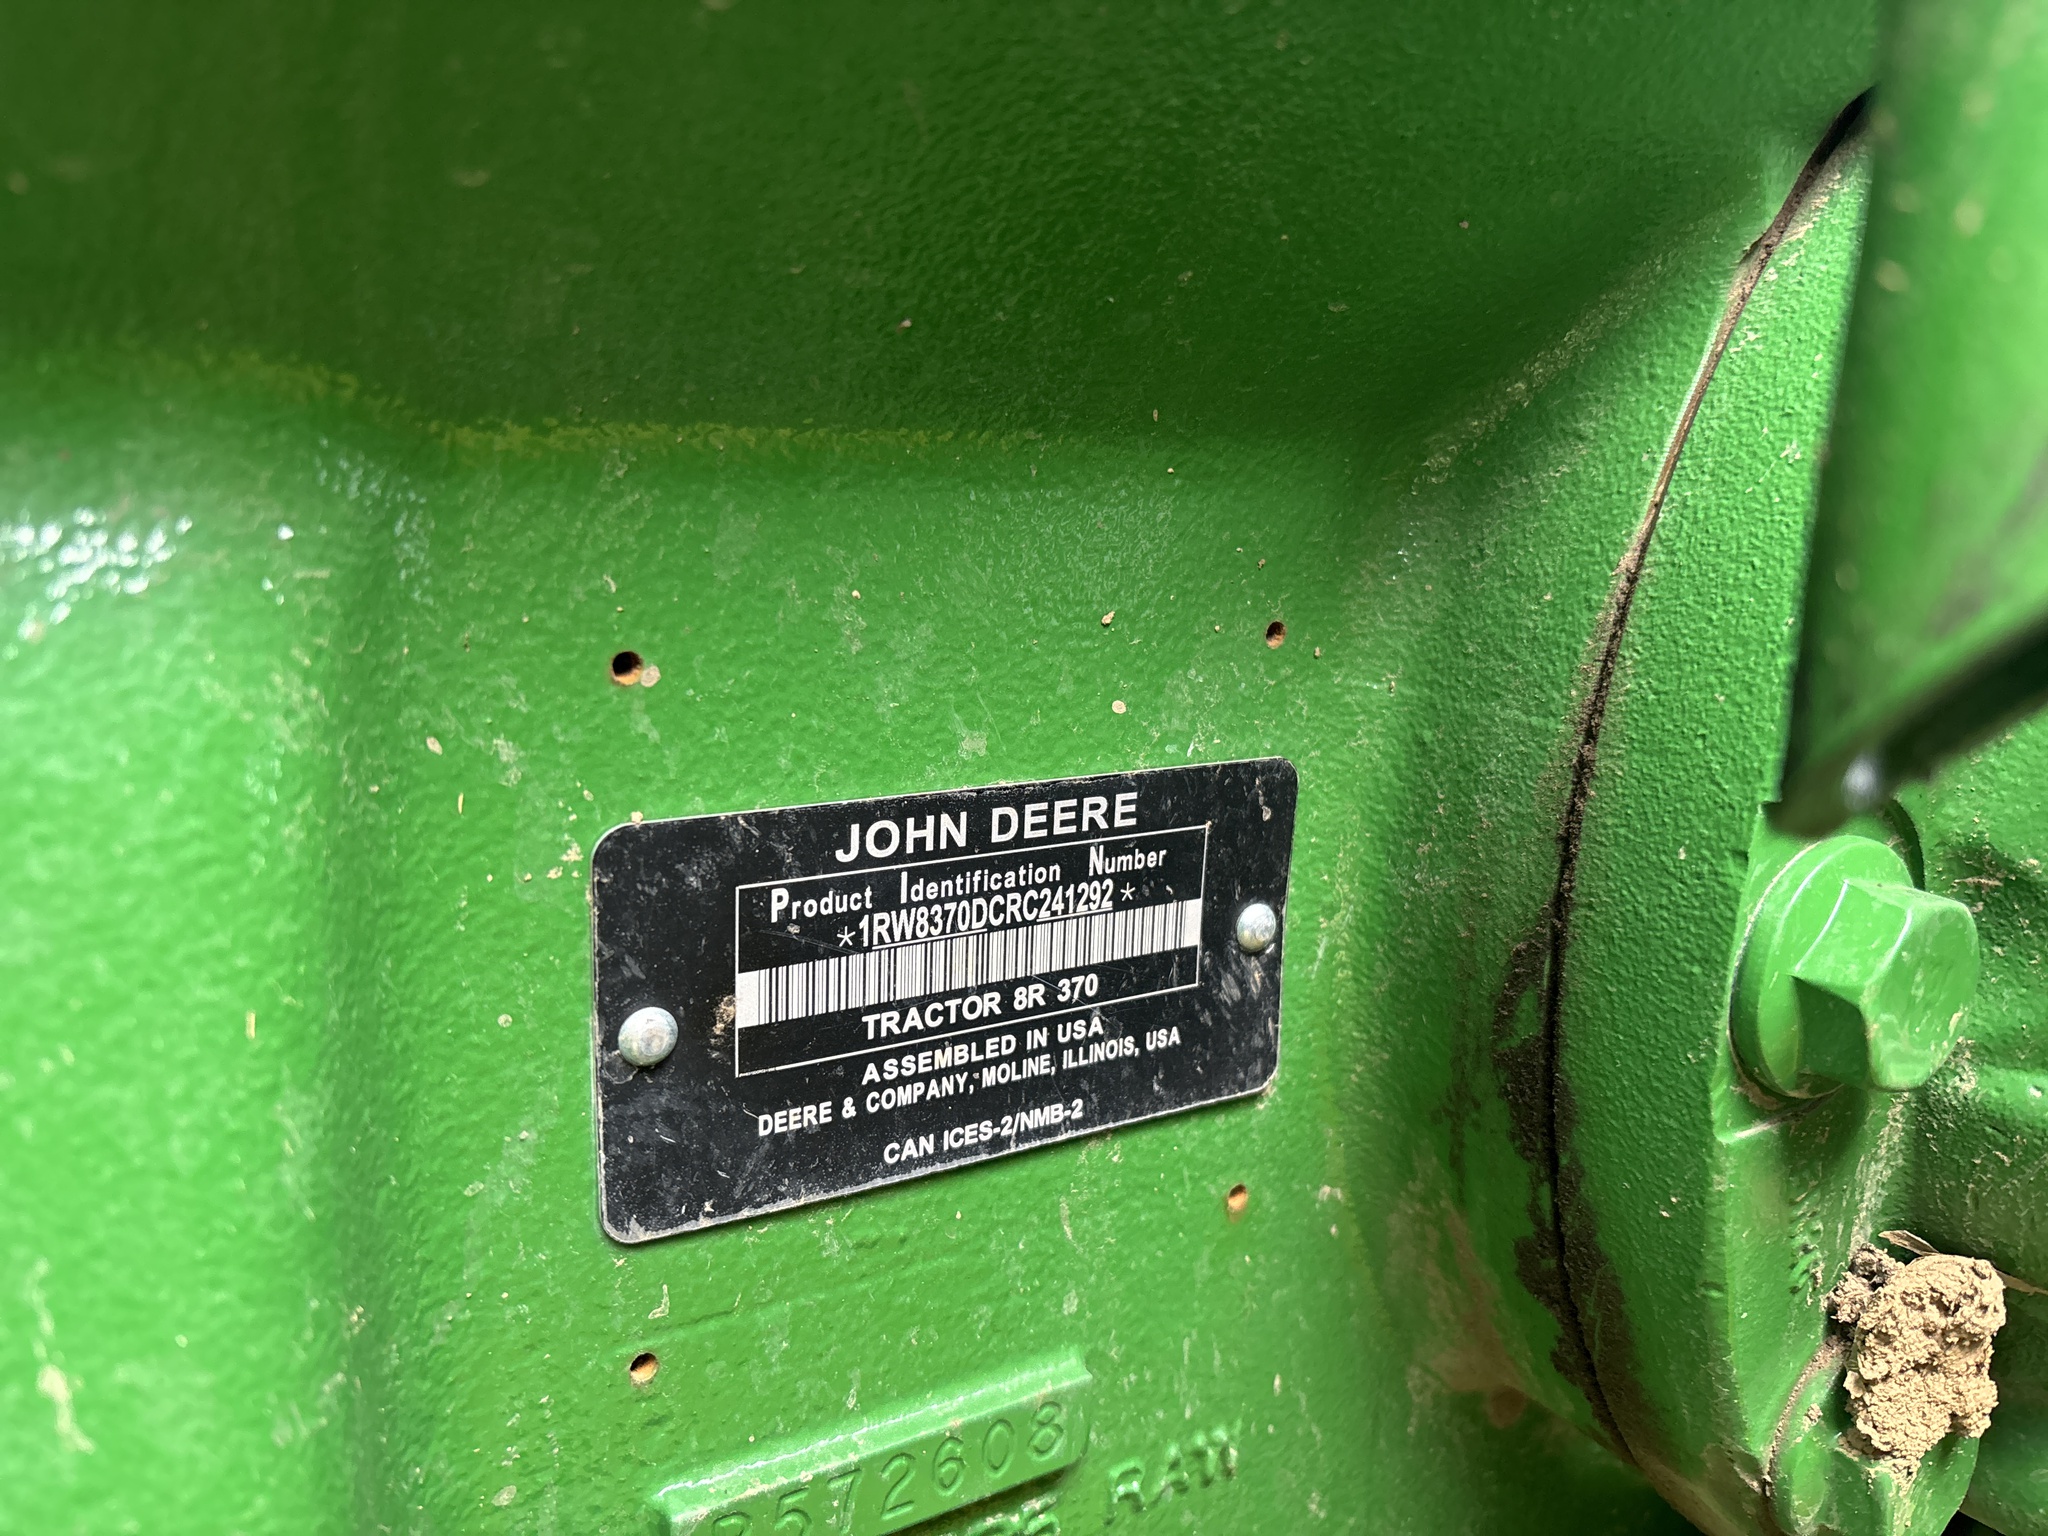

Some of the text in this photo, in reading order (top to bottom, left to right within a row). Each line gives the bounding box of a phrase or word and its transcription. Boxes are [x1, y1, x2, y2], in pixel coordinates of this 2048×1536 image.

[835, 792, 1138, 863] JOHN DEERE
[770, 844, 1167, 923] Product Identification Number
[862, 973, 1099, 1040] TRACTOR 8R 370
[758, 1026, 1181, 1136] DEERE & COMPANY, MOLINE, ILLINOIS, USA
[861, 1016, 1104, 1085] ASSEMBLED IN USA
[883, 1099, 1083, 1165] CAN ICES-2/NMB-2
